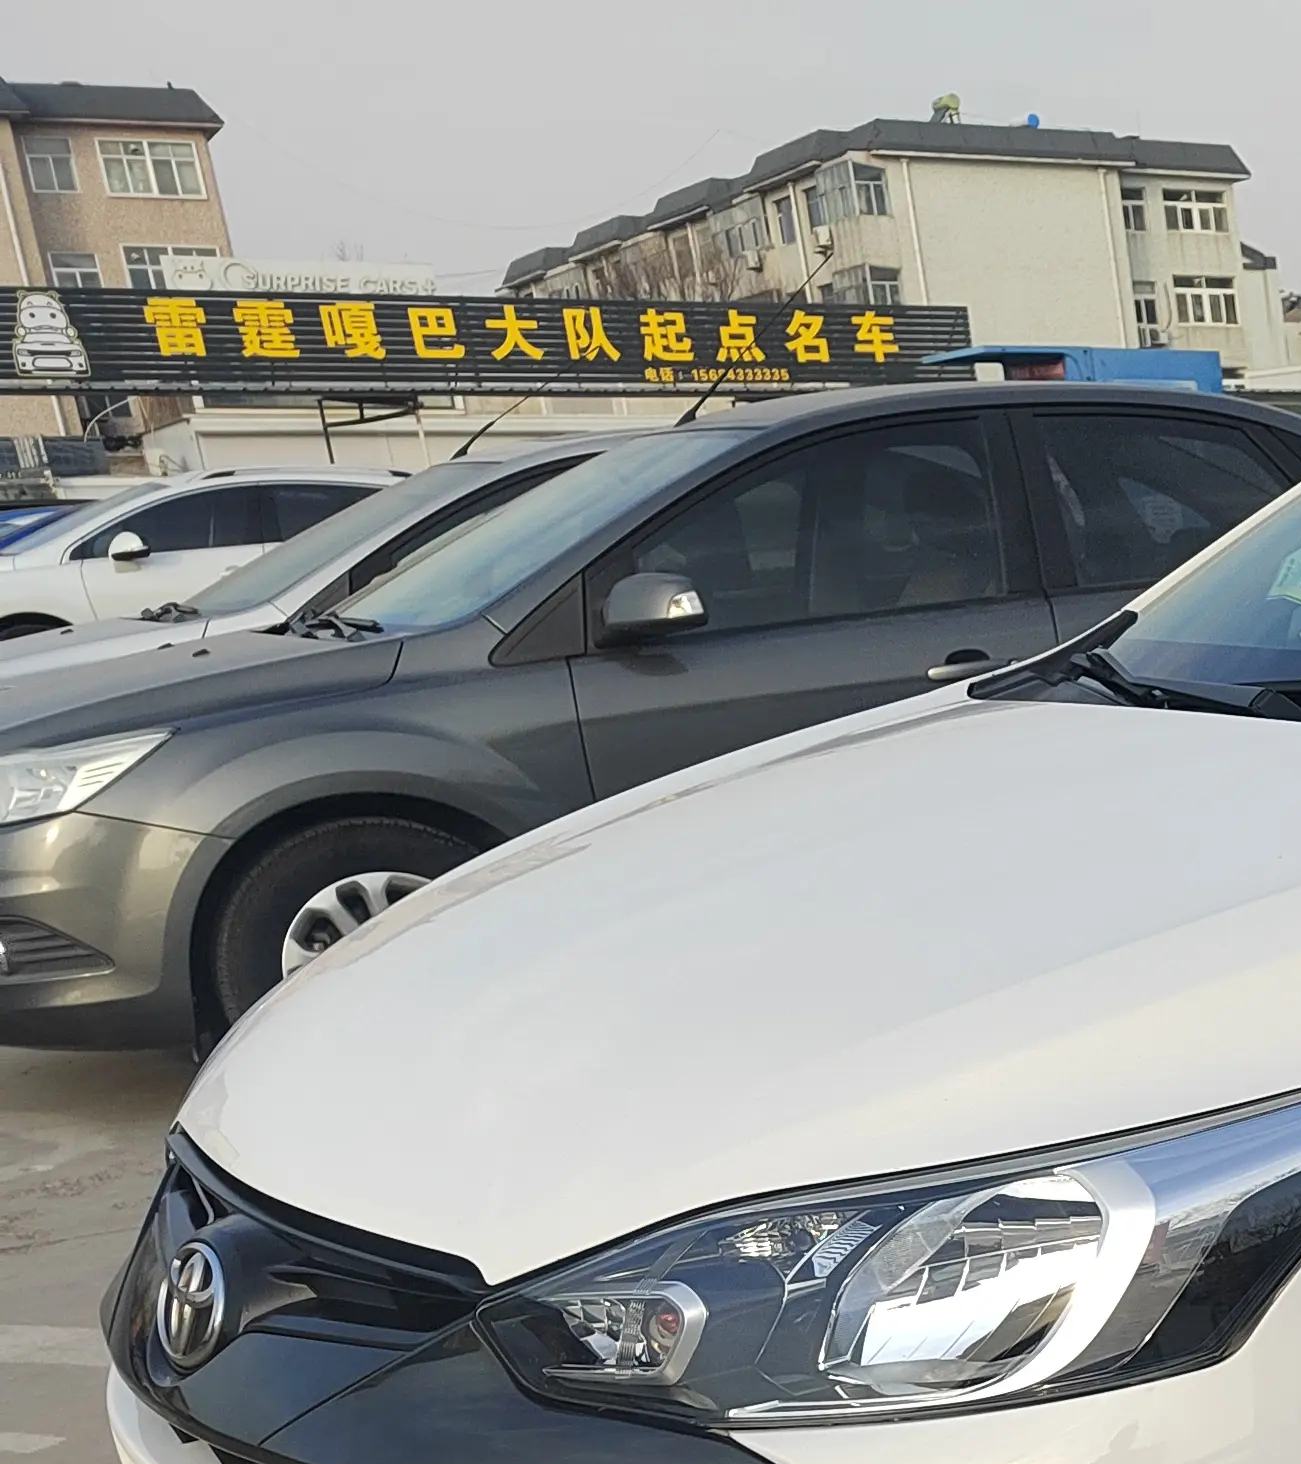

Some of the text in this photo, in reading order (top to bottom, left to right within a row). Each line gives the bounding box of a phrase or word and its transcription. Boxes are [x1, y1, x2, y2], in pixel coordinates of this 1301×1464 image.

[241, 271, 350, 292] SURPRISE
[143, 297, 899, 363] 雷霆嘎巴大队起点名车
